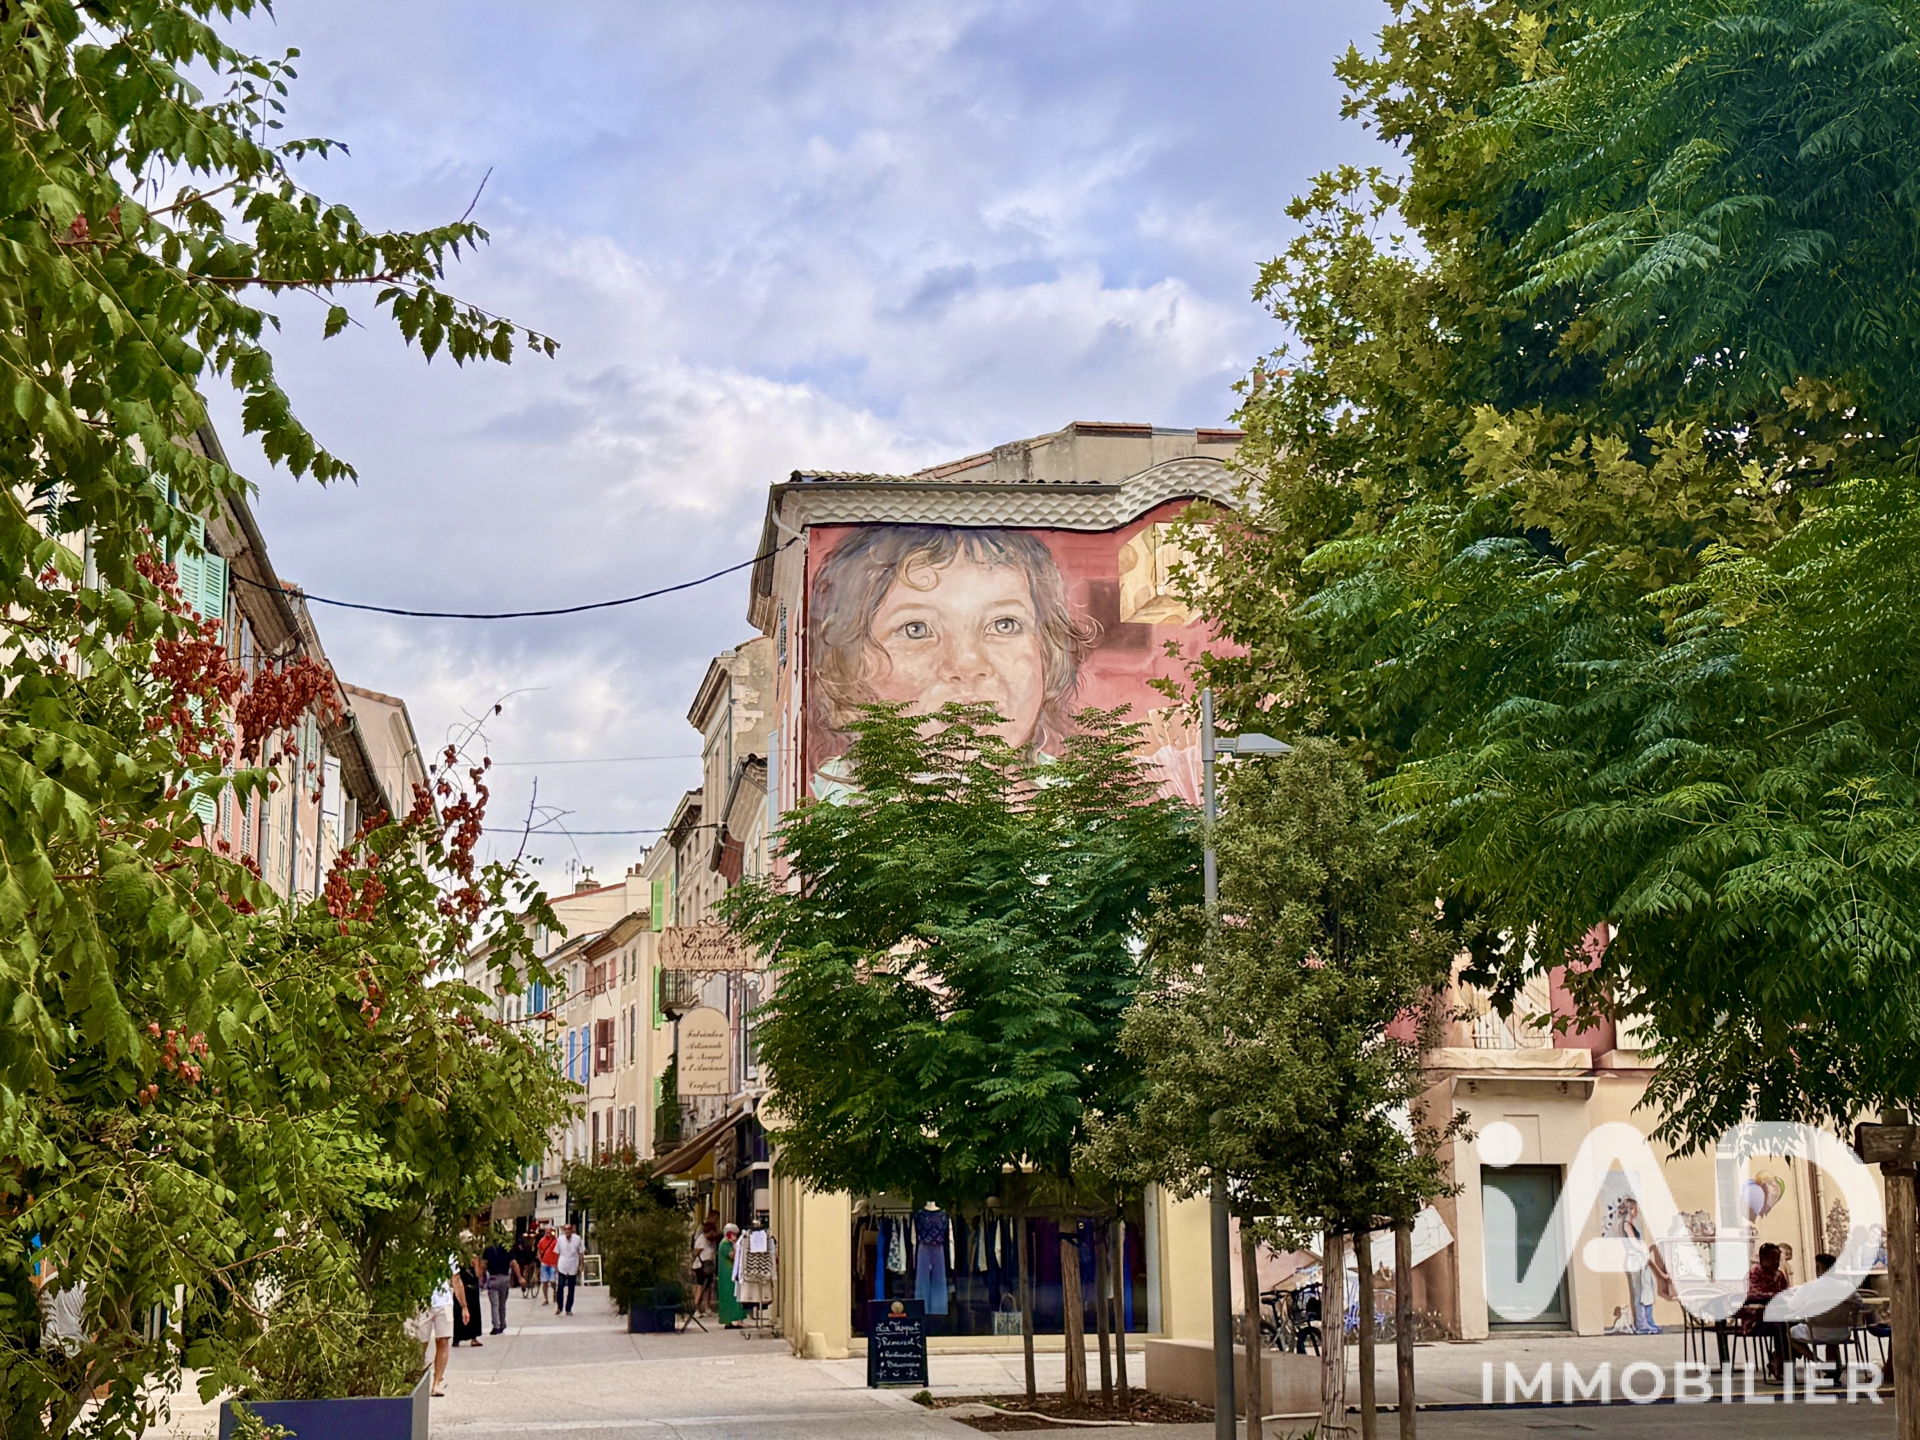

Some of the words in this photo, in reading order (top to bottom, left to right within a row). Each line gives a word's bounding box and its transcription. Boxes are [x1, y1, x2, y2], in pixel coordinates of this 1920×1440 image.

[686, 1030, 724, 1038] Fabrication
[686, 1041, 722, 1049] Artisanale
[697, 1053, 724, 1063] Nougat
